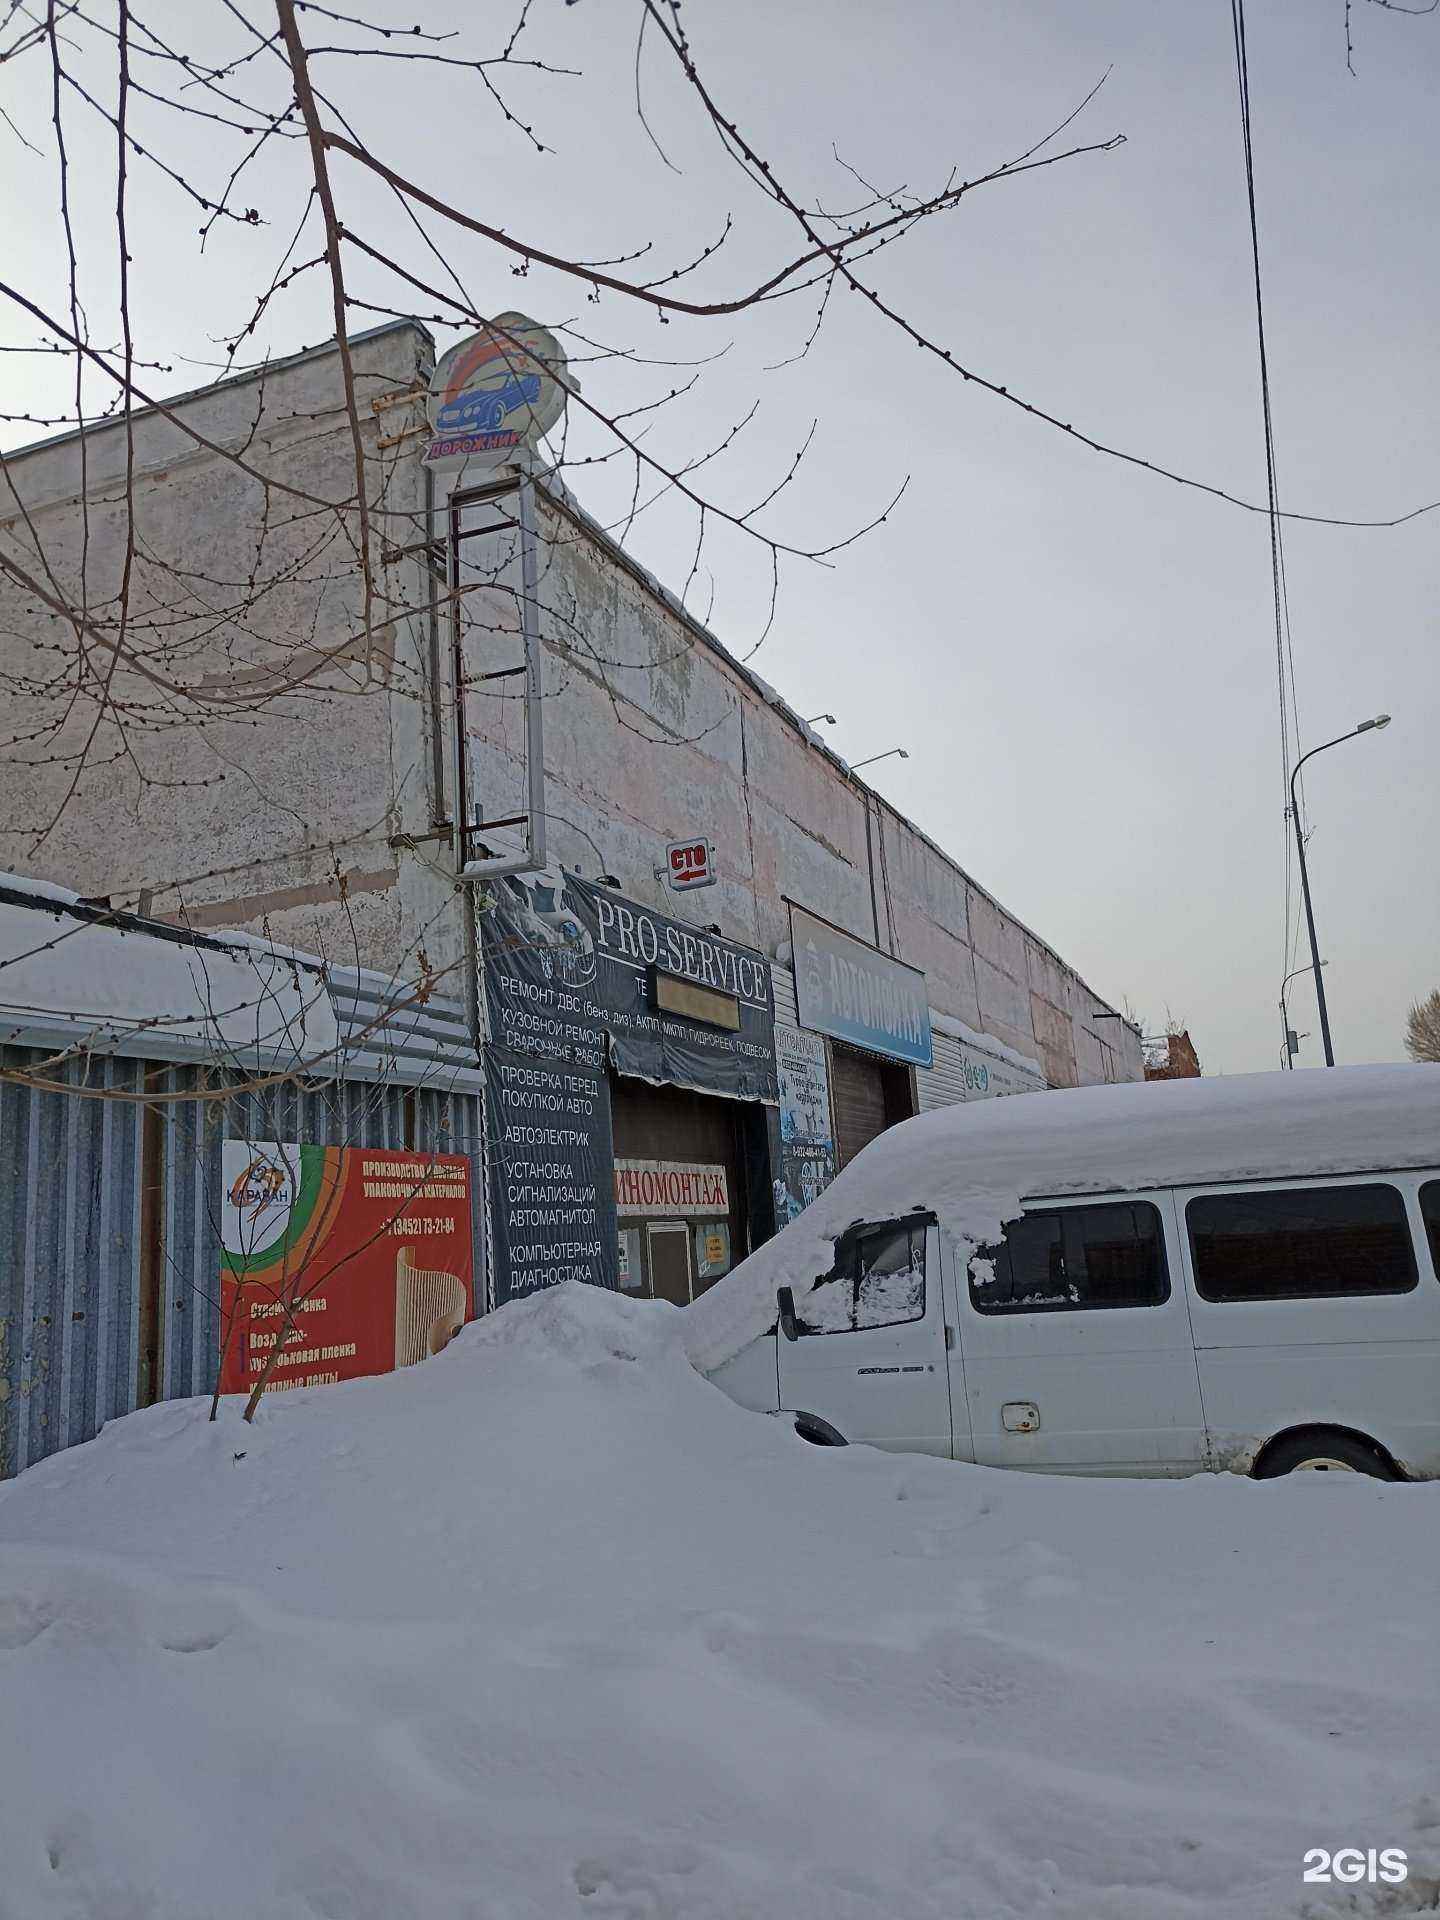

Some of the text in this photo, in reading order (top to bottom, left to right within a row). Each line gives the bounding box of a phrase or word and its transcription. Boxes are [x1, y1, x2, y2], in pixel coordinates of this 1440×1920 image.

[671, 845, 706, 870] СТО
[593, 896, 767, 1001] PRO-SERVICE
[635, 976, 648, 996] ТЕ
[501, 976, 555, 1004] РЕМОНТ
[558, 993, 580, 1012] ДВС
[736, 1040, 772, 1060] ПОДВЕСКИ
[502, 1008, 605, 1046] КУЗОВНОЙ РЕМОНТ
[506, 1030, 606, 1070] СВАРОЧНЫЕ РАБОТ
[502, 1066, 599, 1097] ПРОВЕРКА ПЕРЕД
[502, 1089, 592, 1115] ПОКУПКОЙ АВТО
[505, 1126, 589, 1146] АВТОЭЛЕКТРИК
[363, 1161, 425, 1180] ПРОИЗВОДСТВО
[506, 1161, 573, 1179] УСТАНОВКА
[425, 1185, 466, 1199] МАТЕРИАЛОВ
[508, 1184, 596, 1205] СИГНАЛИЗАЦИЙ
[614, 1169, 727, 1205] ИНОМОНТАЖ
[394, 1218, 422, 1236] (3452)
[423, 1217, 455, 1235] 73-21-84
[509, 1208, 596, 1227] АВТОМАГНИТОЛ
[509, 1241, 600, 1263] КОМПЬЮТЕРНАЯ
[510, 1264, 592, 1291] ДИАГНОСТИКА
[249, 1342, 356, 1372] пузрьковая пленка
